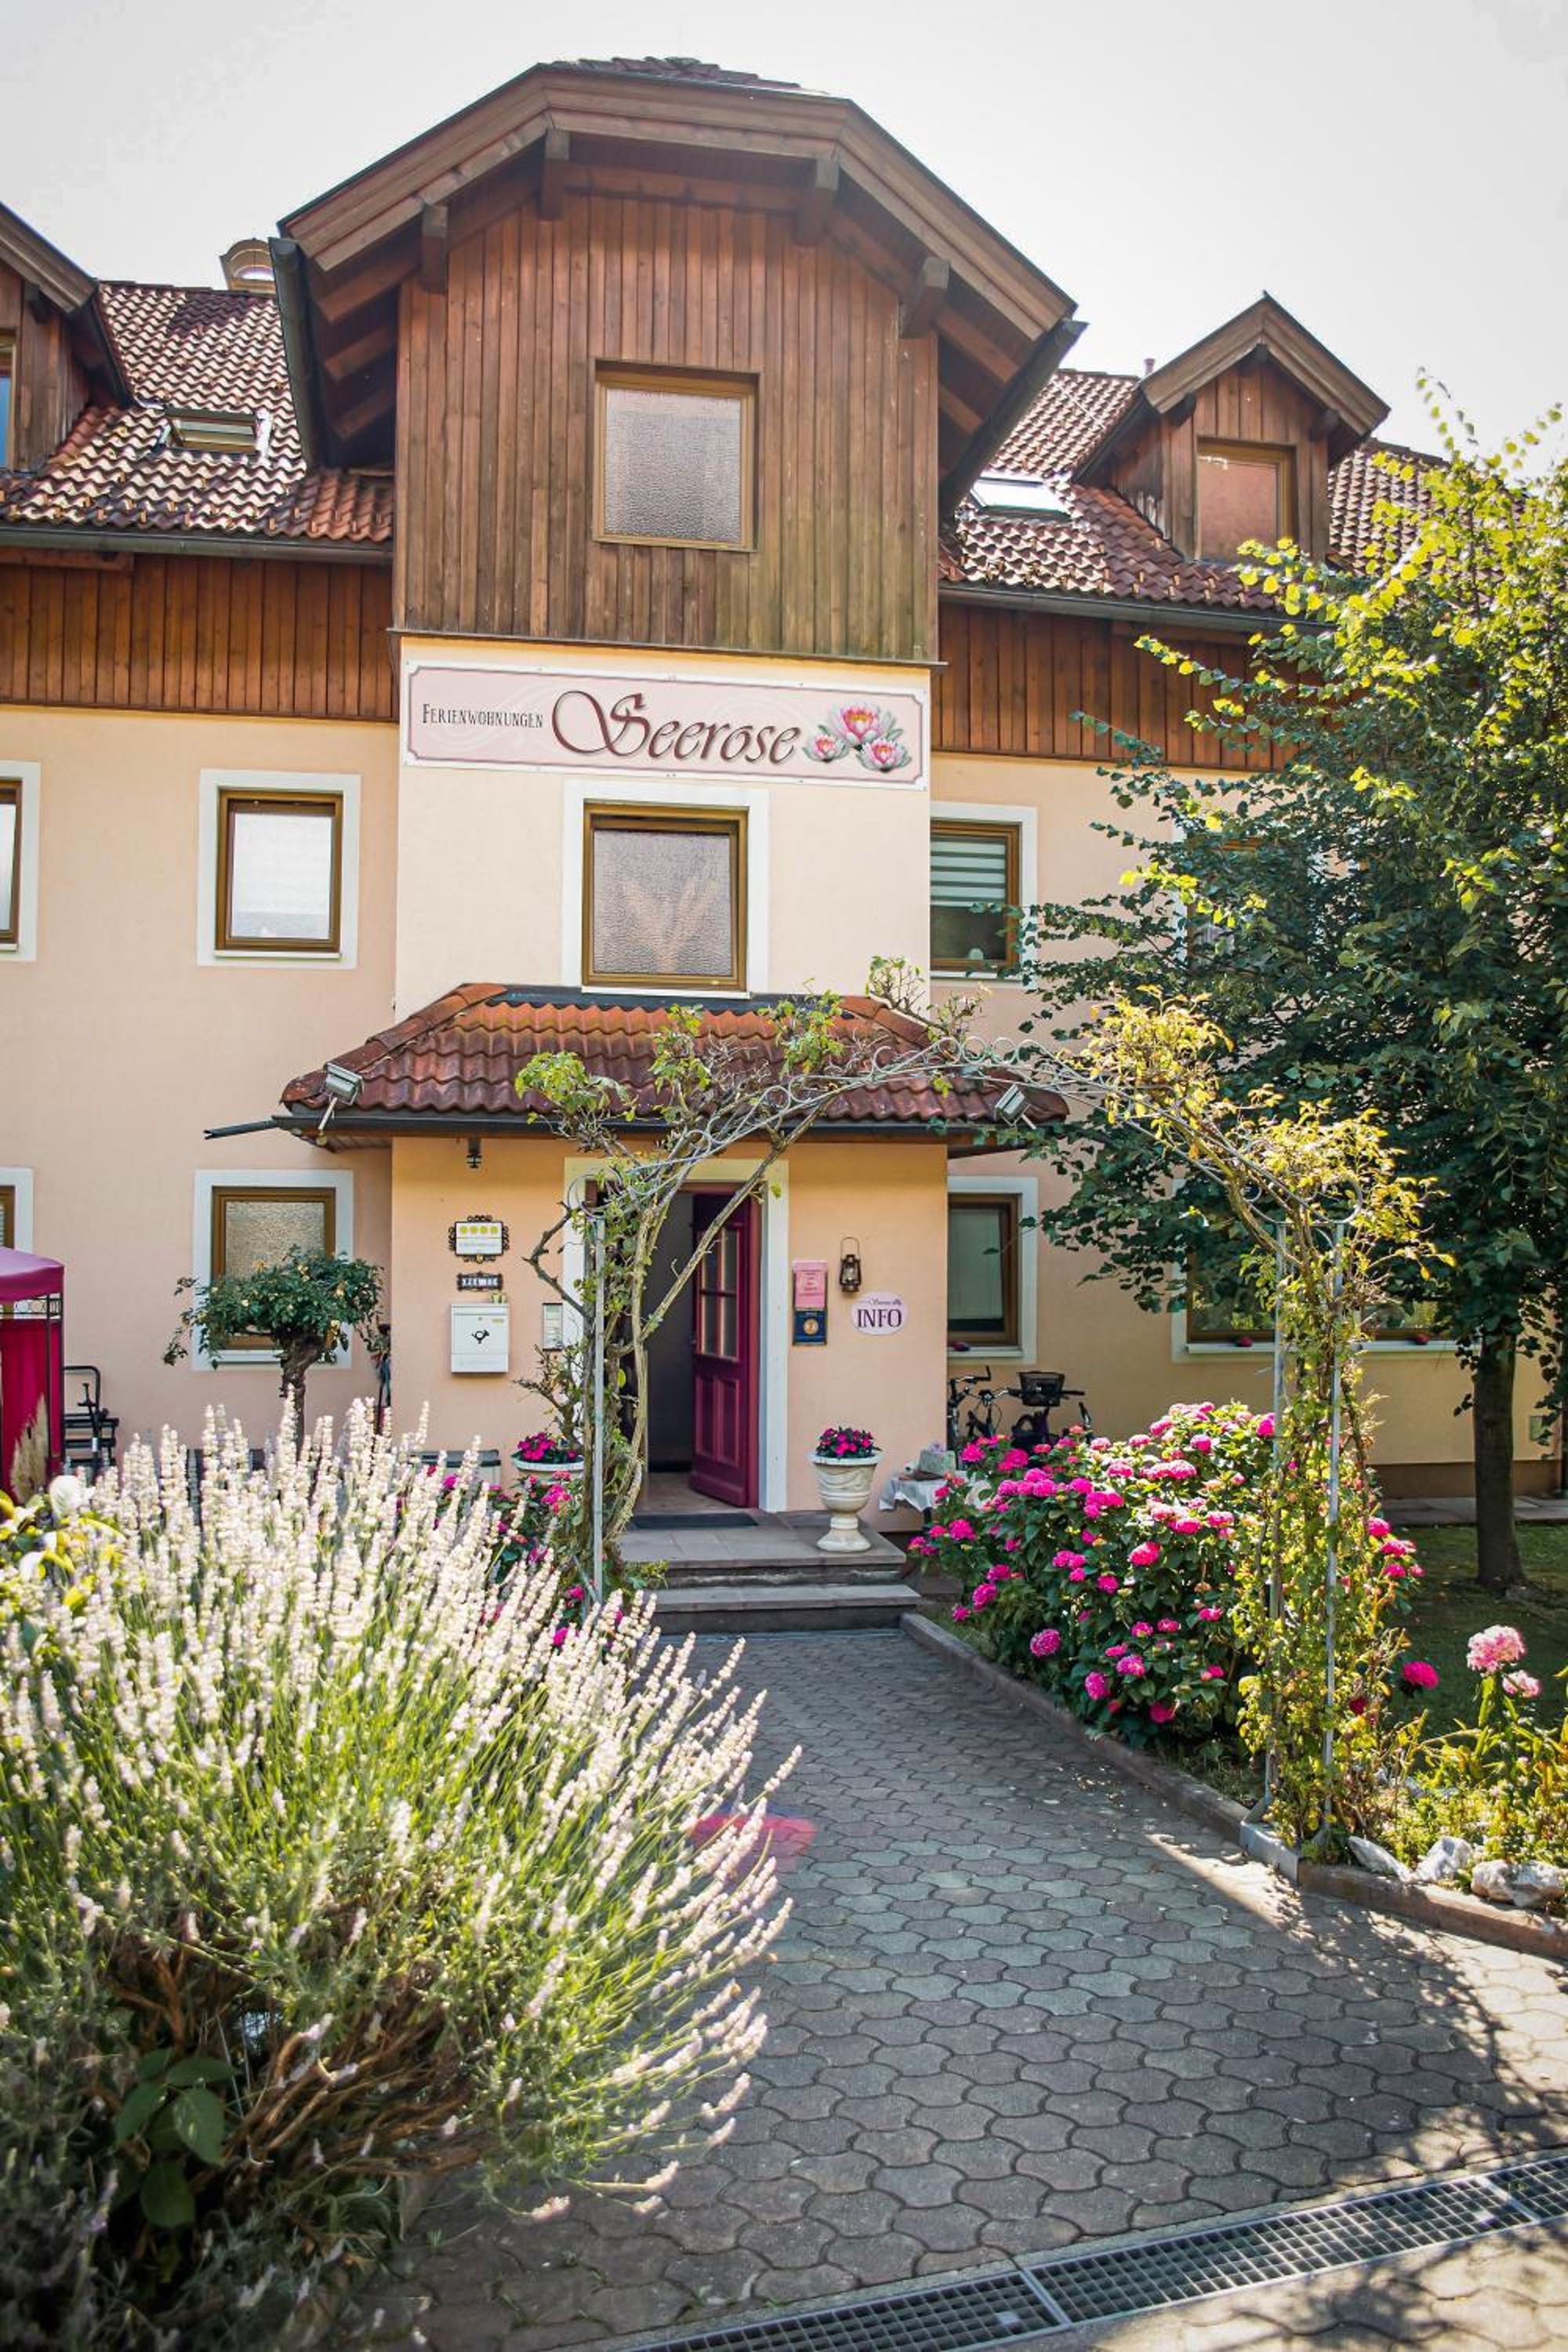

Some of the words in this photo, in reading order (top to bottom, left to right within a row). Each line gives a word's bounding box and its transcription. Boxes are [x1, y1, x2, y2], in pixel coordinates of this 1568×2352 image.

[422, 703, 543, 728] FERIENWOHNUNGEN
[552, 689, 801, 765] Seerose
[858, 1308, 902, 1327] INFO
